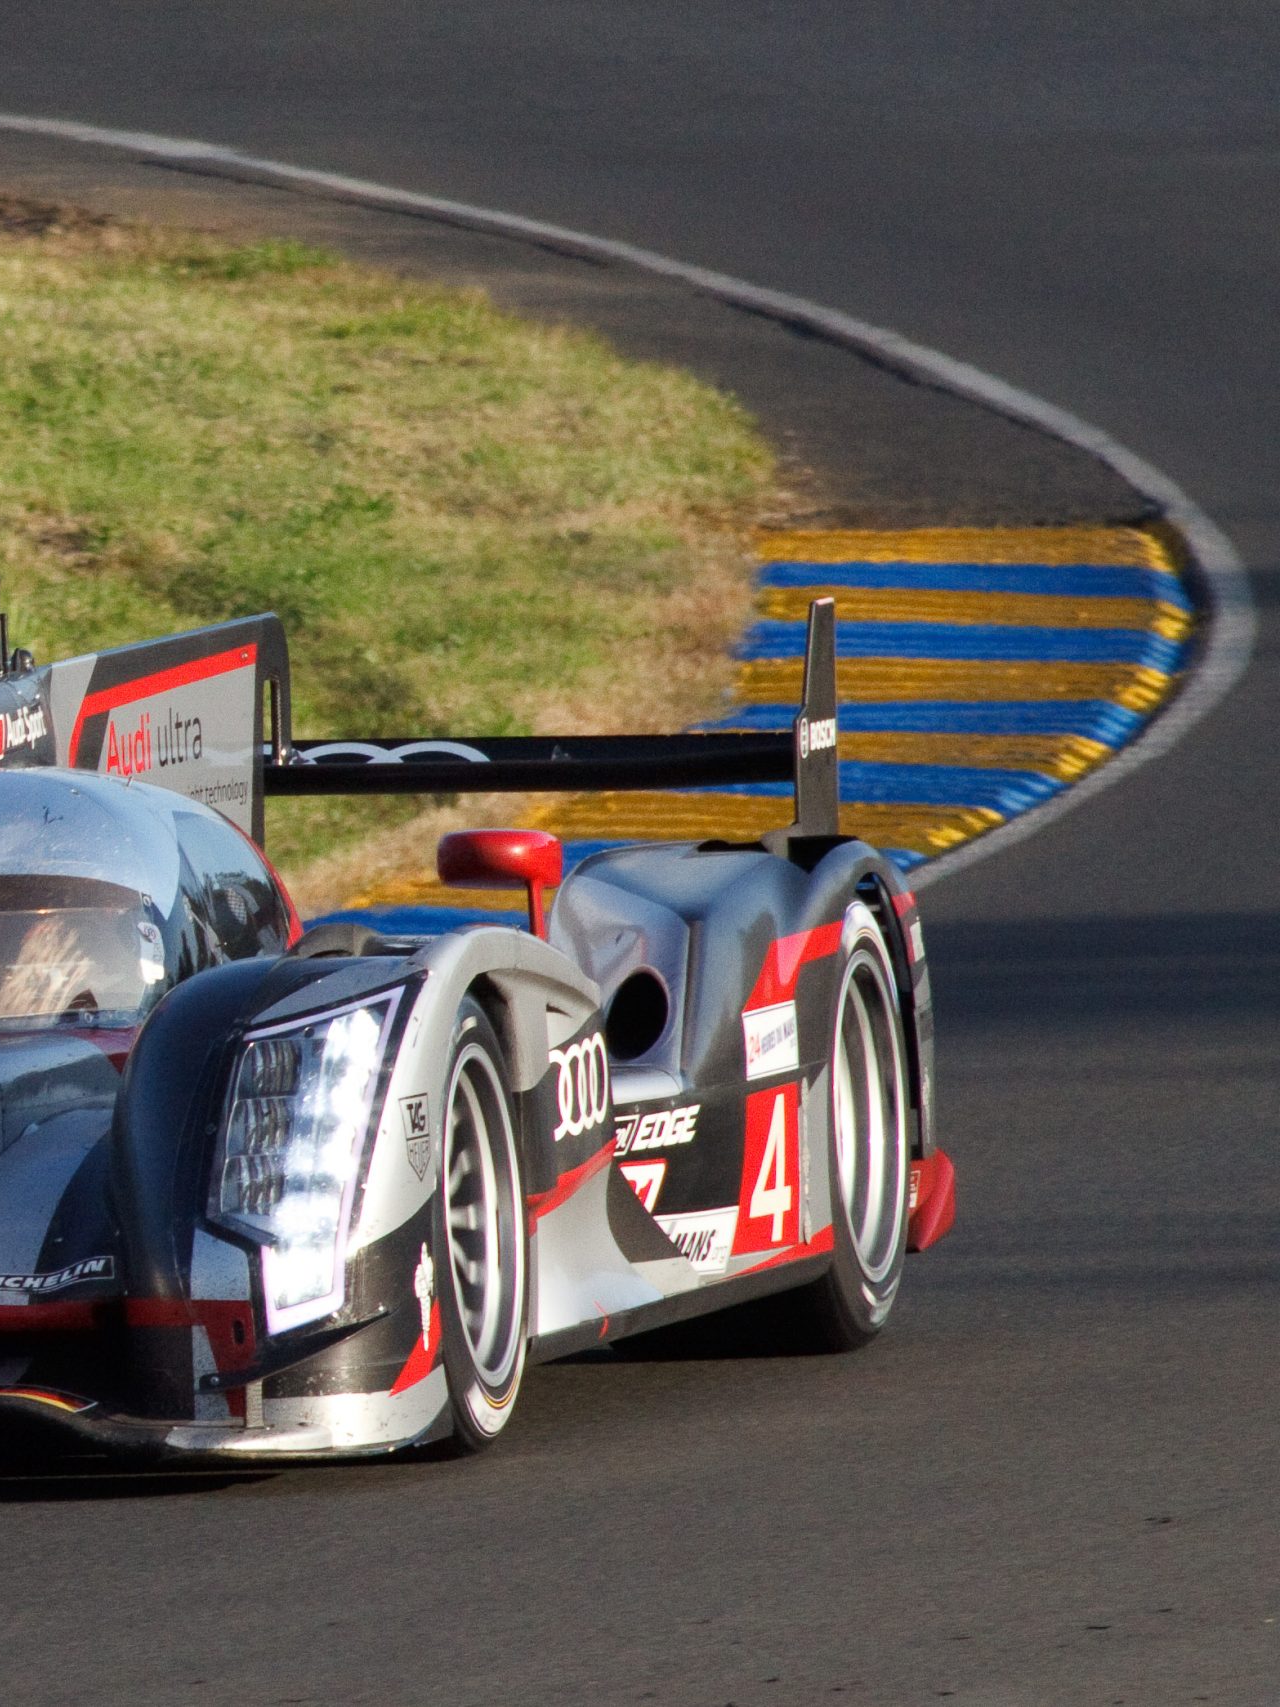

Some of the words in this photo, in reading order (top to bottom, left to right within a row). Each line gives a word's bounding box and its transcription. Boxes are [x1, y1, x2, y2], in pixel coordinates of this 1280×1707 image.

[6, 712, 26, 748] Audi
[23, 706, 47, 750] Sport
[106, 712, 152, 776] Audi
[157, 707, 203, 767] ultra
[810, 718, 836, 751] BOSCH
[204, 778, 248, 806] technology
[406, 1101, 426, 1134] TAG
[630, 1104, 701, 1151] EDGE
[749, 1093, 792, 1243] 4
